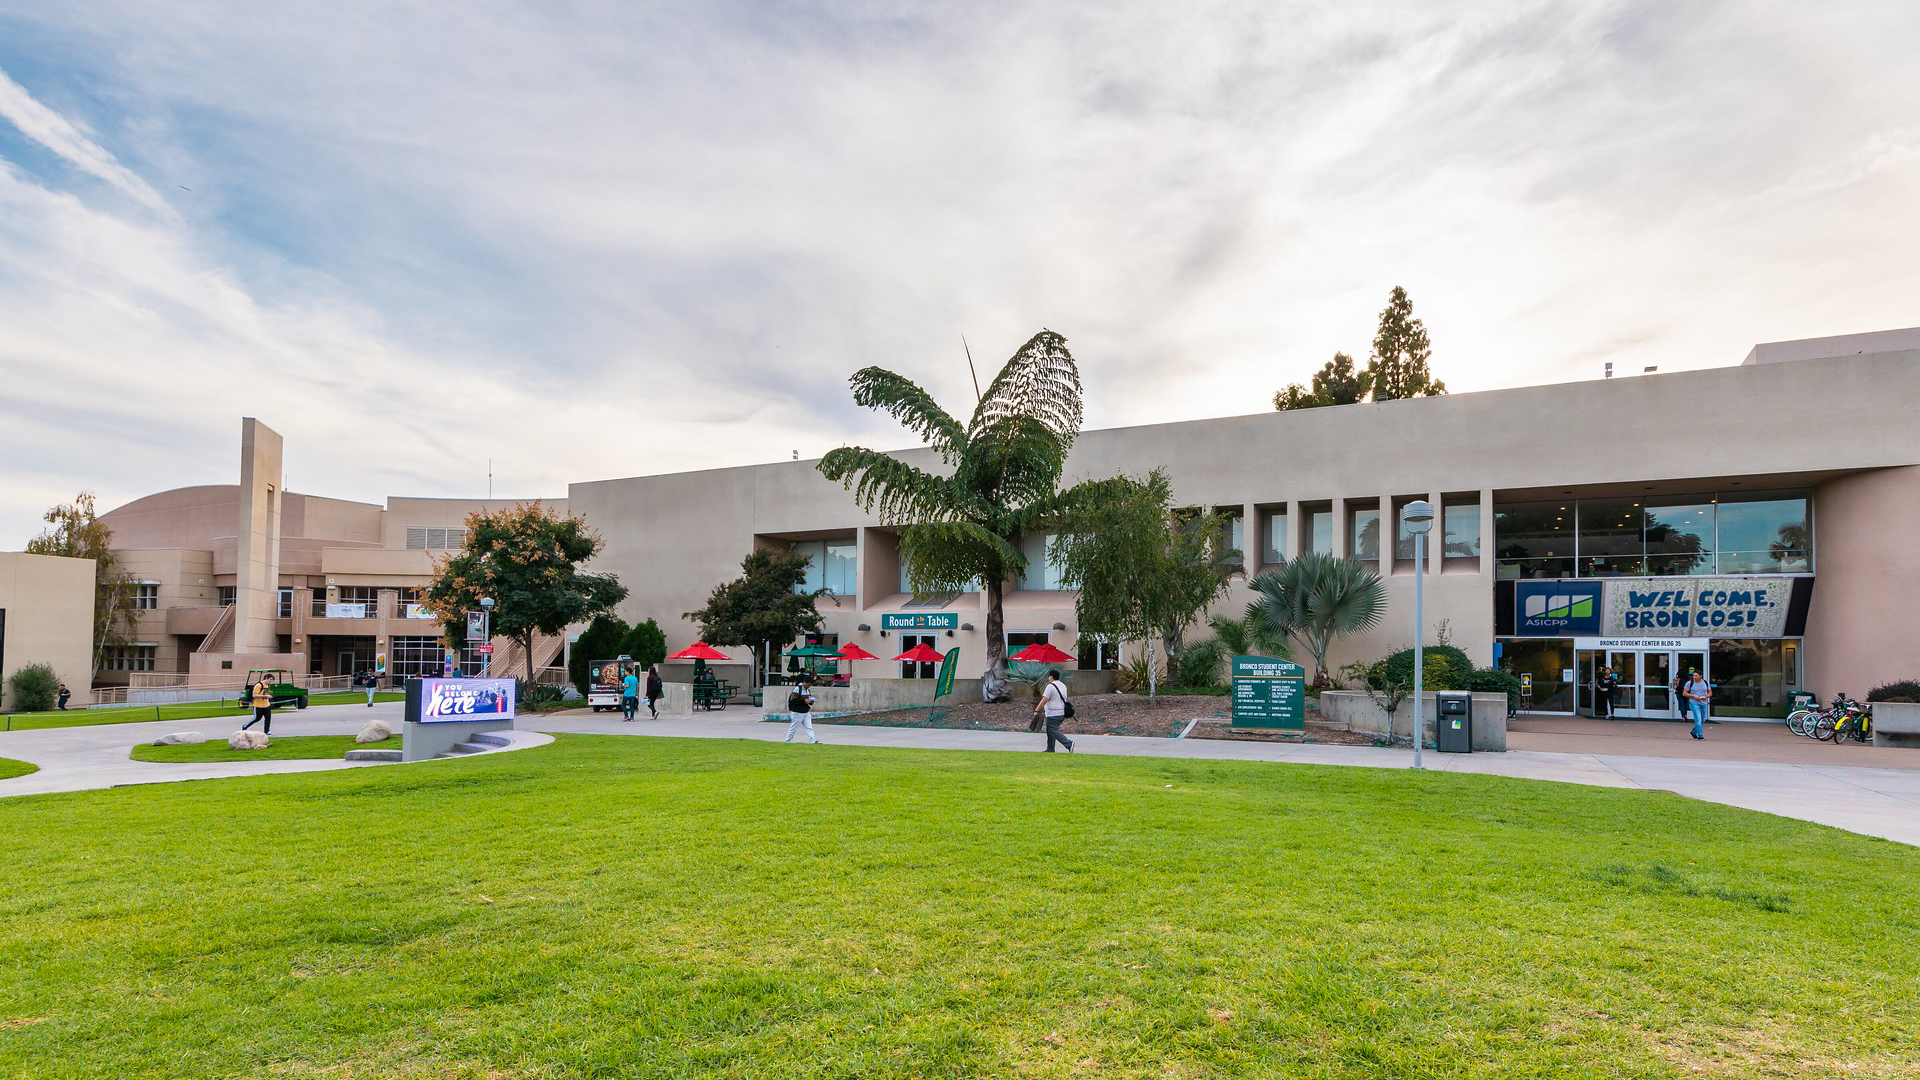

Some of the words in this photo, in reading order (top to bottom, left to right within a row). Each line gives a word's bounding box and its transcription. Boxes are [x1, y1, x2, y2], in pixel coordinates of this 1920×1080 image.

[889, 615, 914, 627] Round
[927, 615, 949, 627] Table
[425, 684, 475, 717] here
